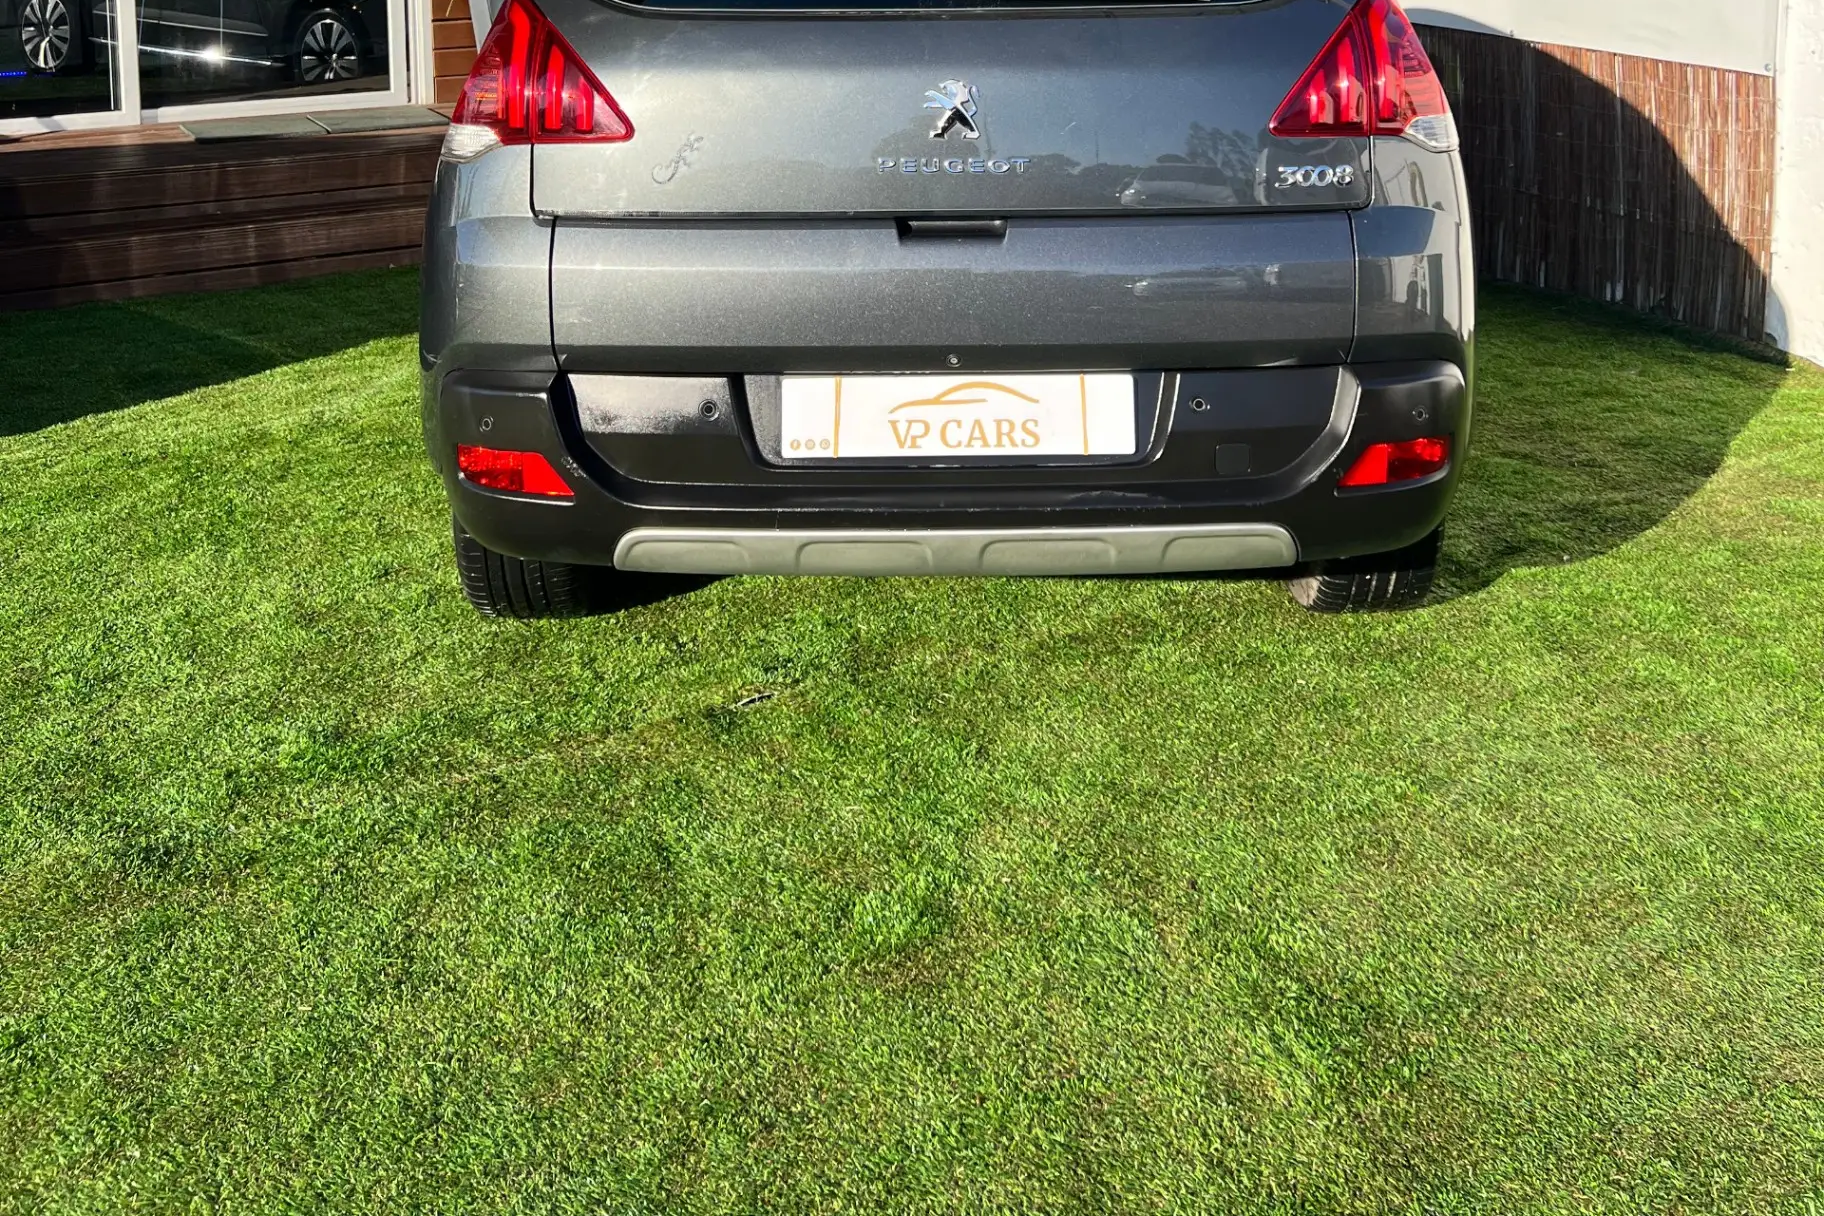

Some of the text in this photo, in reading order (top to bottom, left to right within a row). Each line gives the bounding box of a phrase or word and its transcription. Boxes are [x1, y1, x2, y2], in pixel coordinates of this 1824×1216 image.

[877, 157, 1031, 174] PEUGEOT
[1274, 164, 1355, 189] 3008
[888, 418, 1041, 449] VP CARS
